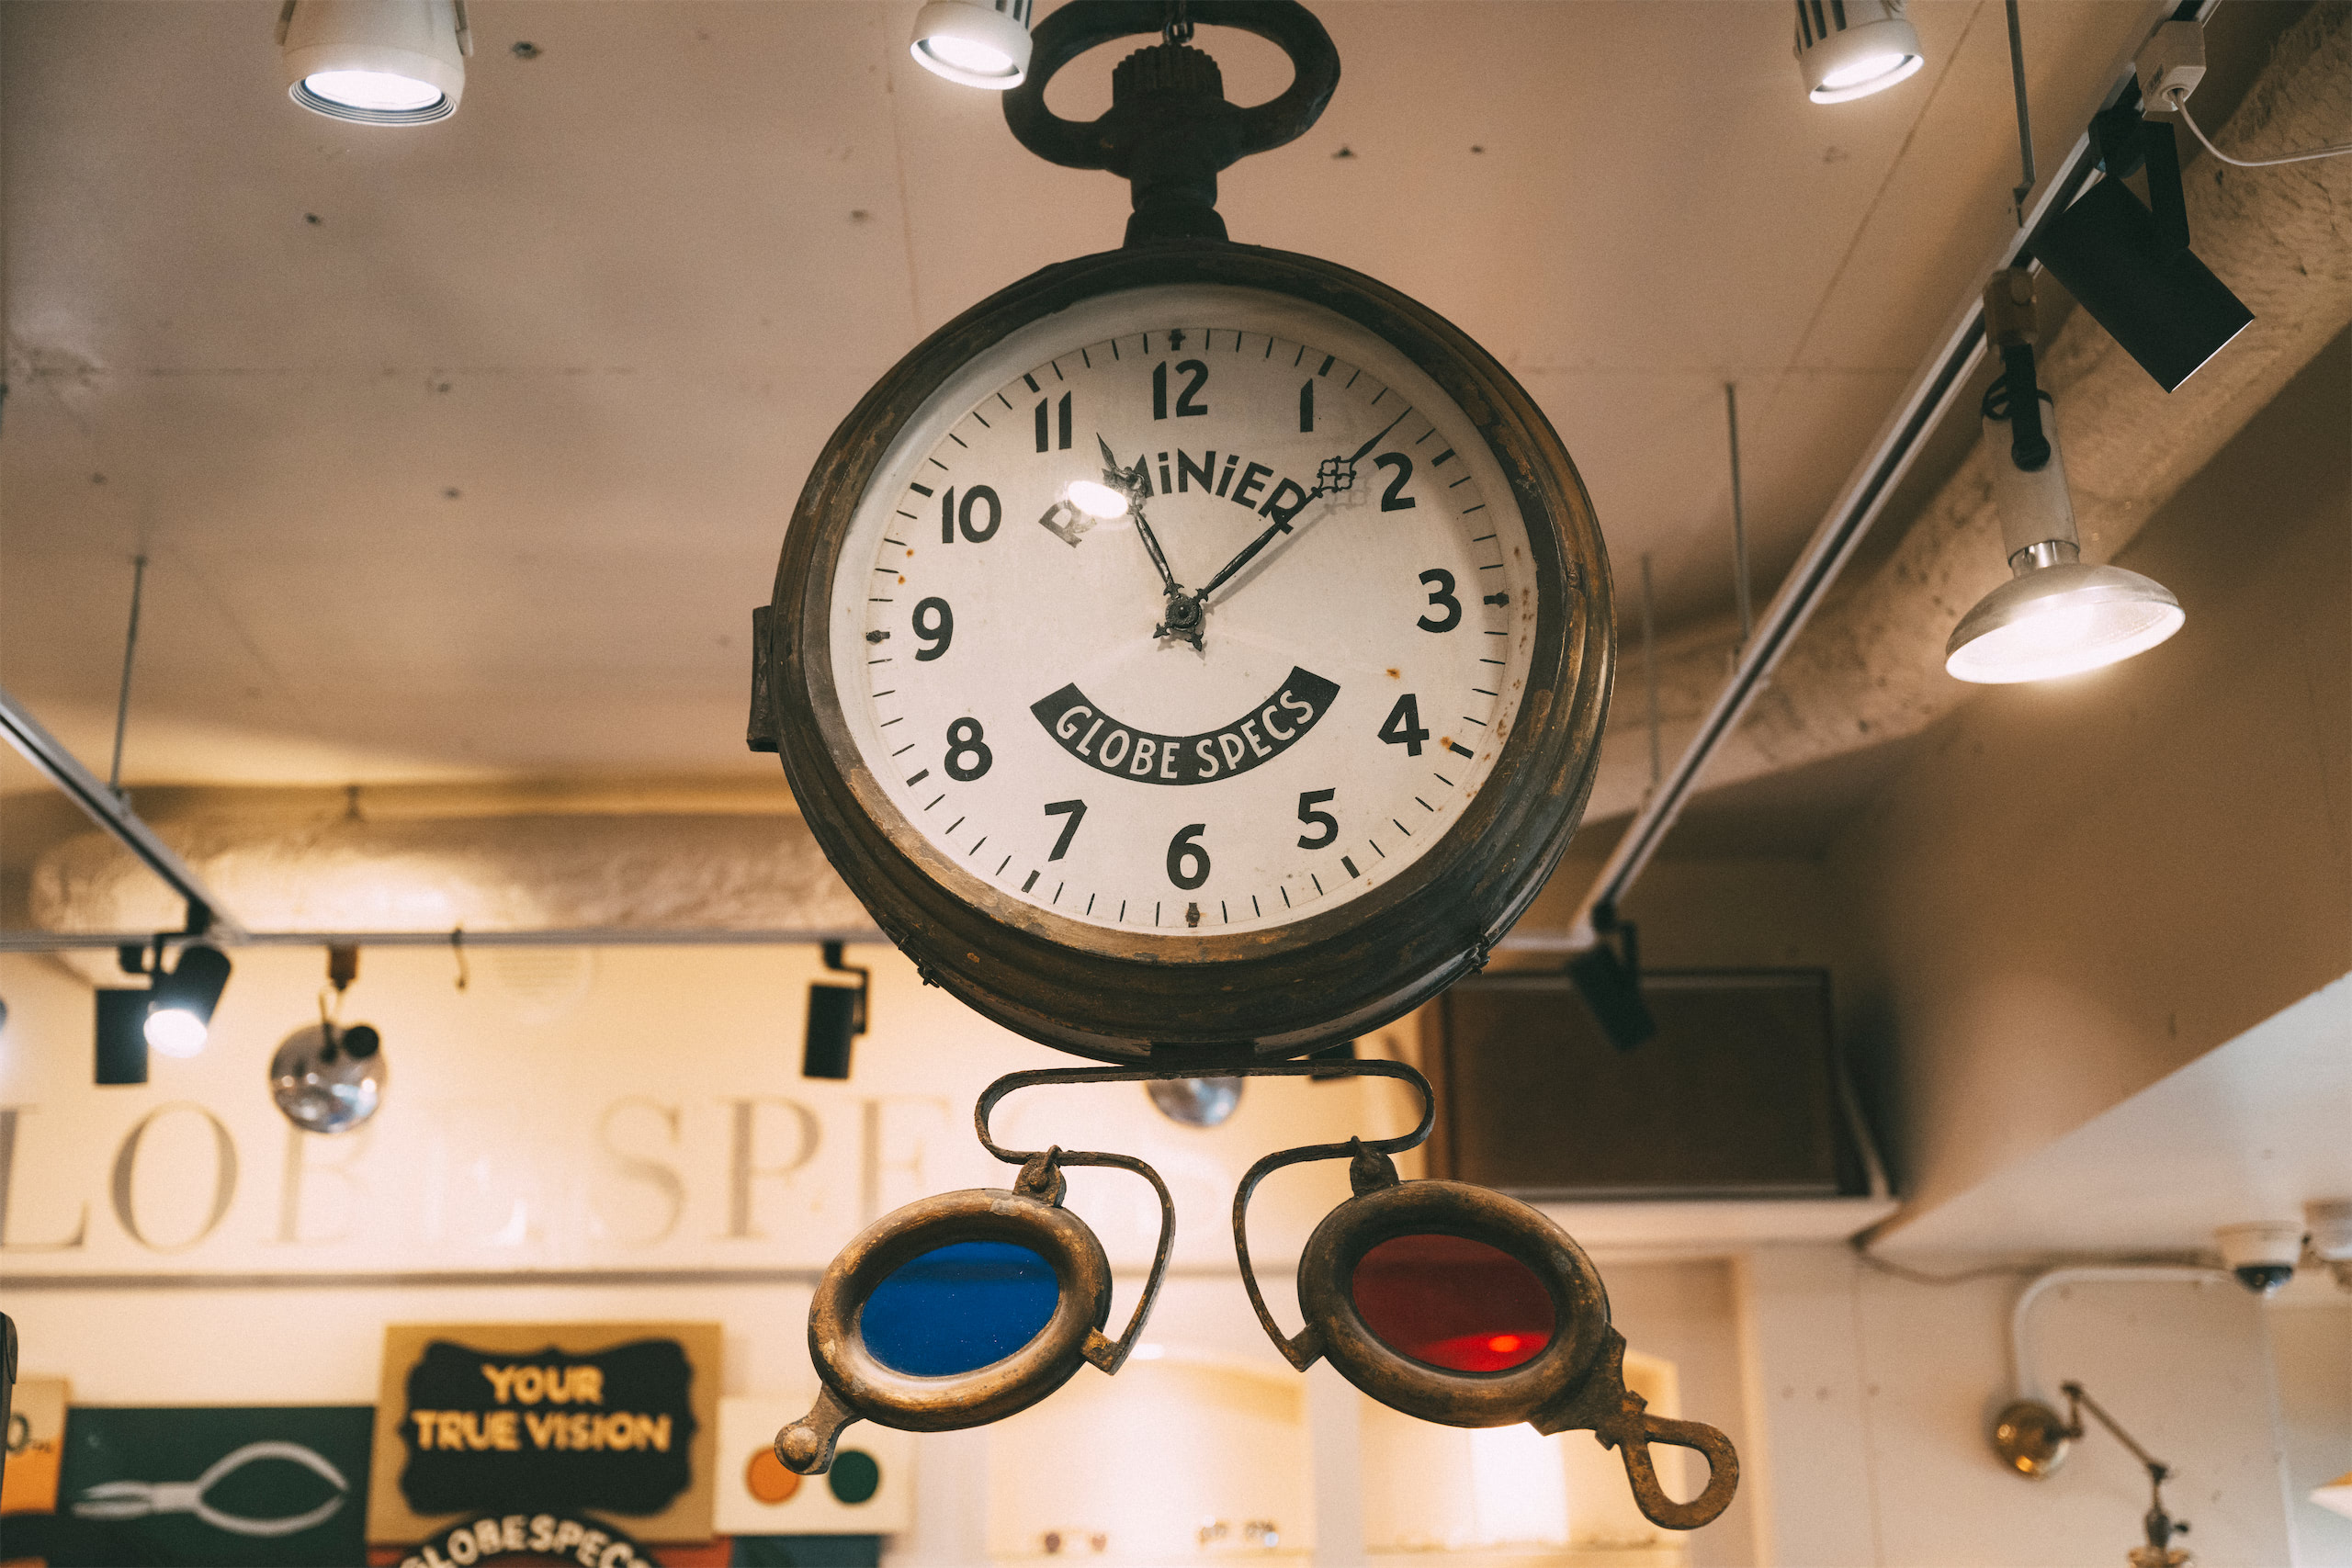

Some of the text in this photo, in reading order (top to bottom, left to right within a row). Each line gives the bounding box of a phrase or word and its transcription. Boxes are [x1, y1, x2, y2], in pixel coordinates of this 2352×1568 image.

[1153, 359, 1208, 420] 12
[1300, 378, 1314, 433] 1
[1035, 390, 1071, 453] 11
[1373, 452, 1416, 512] 2
[943, 485, 1001, 544] 10
[912, 597, 953, 661] 9
[1417, 569, 1462, 633] 3
[944, 717, 992, 782] 8
[1056, 689, 1314, 779] GLOBE SPECS
[1377, 694, 1430, 757] 4
[1045, 799, 1088, 862] 7
[1297, 787, 1338, 850] 5
[1167, 824, 1210, 890] 6
[481, 1364, 604, 1404] YOUR
[412, 1410, 672, 1452] TRUE VISION
